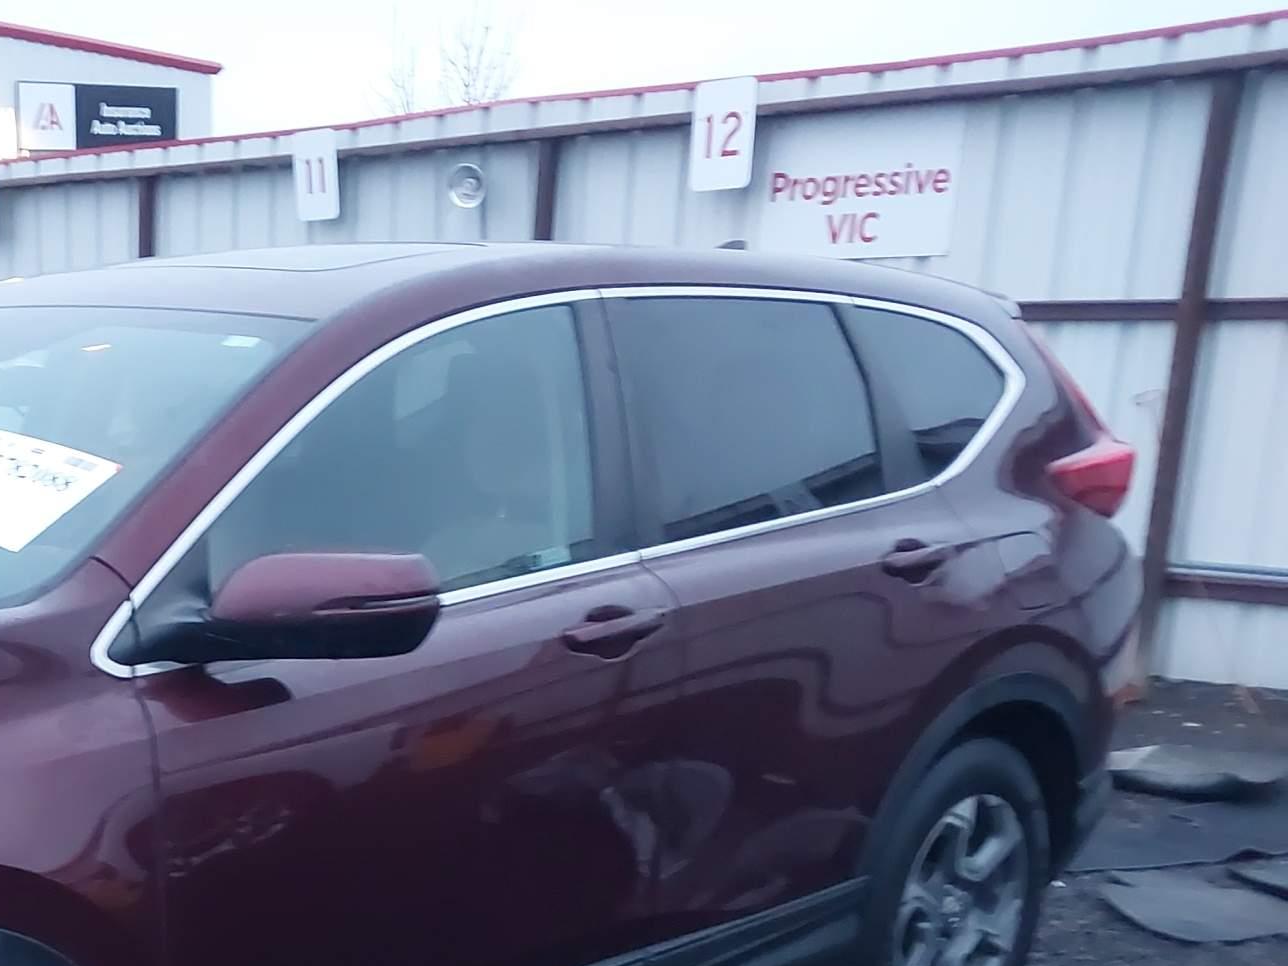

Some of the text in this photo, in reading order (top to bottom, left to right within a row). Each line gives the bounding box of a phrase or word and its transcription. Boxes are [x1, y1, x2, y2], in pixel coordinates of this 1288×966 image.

[703, 111, 742, 159] 12
[302, 157, 329, 194] 11
[770, 163, 951, 205] Progressive
[825, 212, 880, 244] VIC
